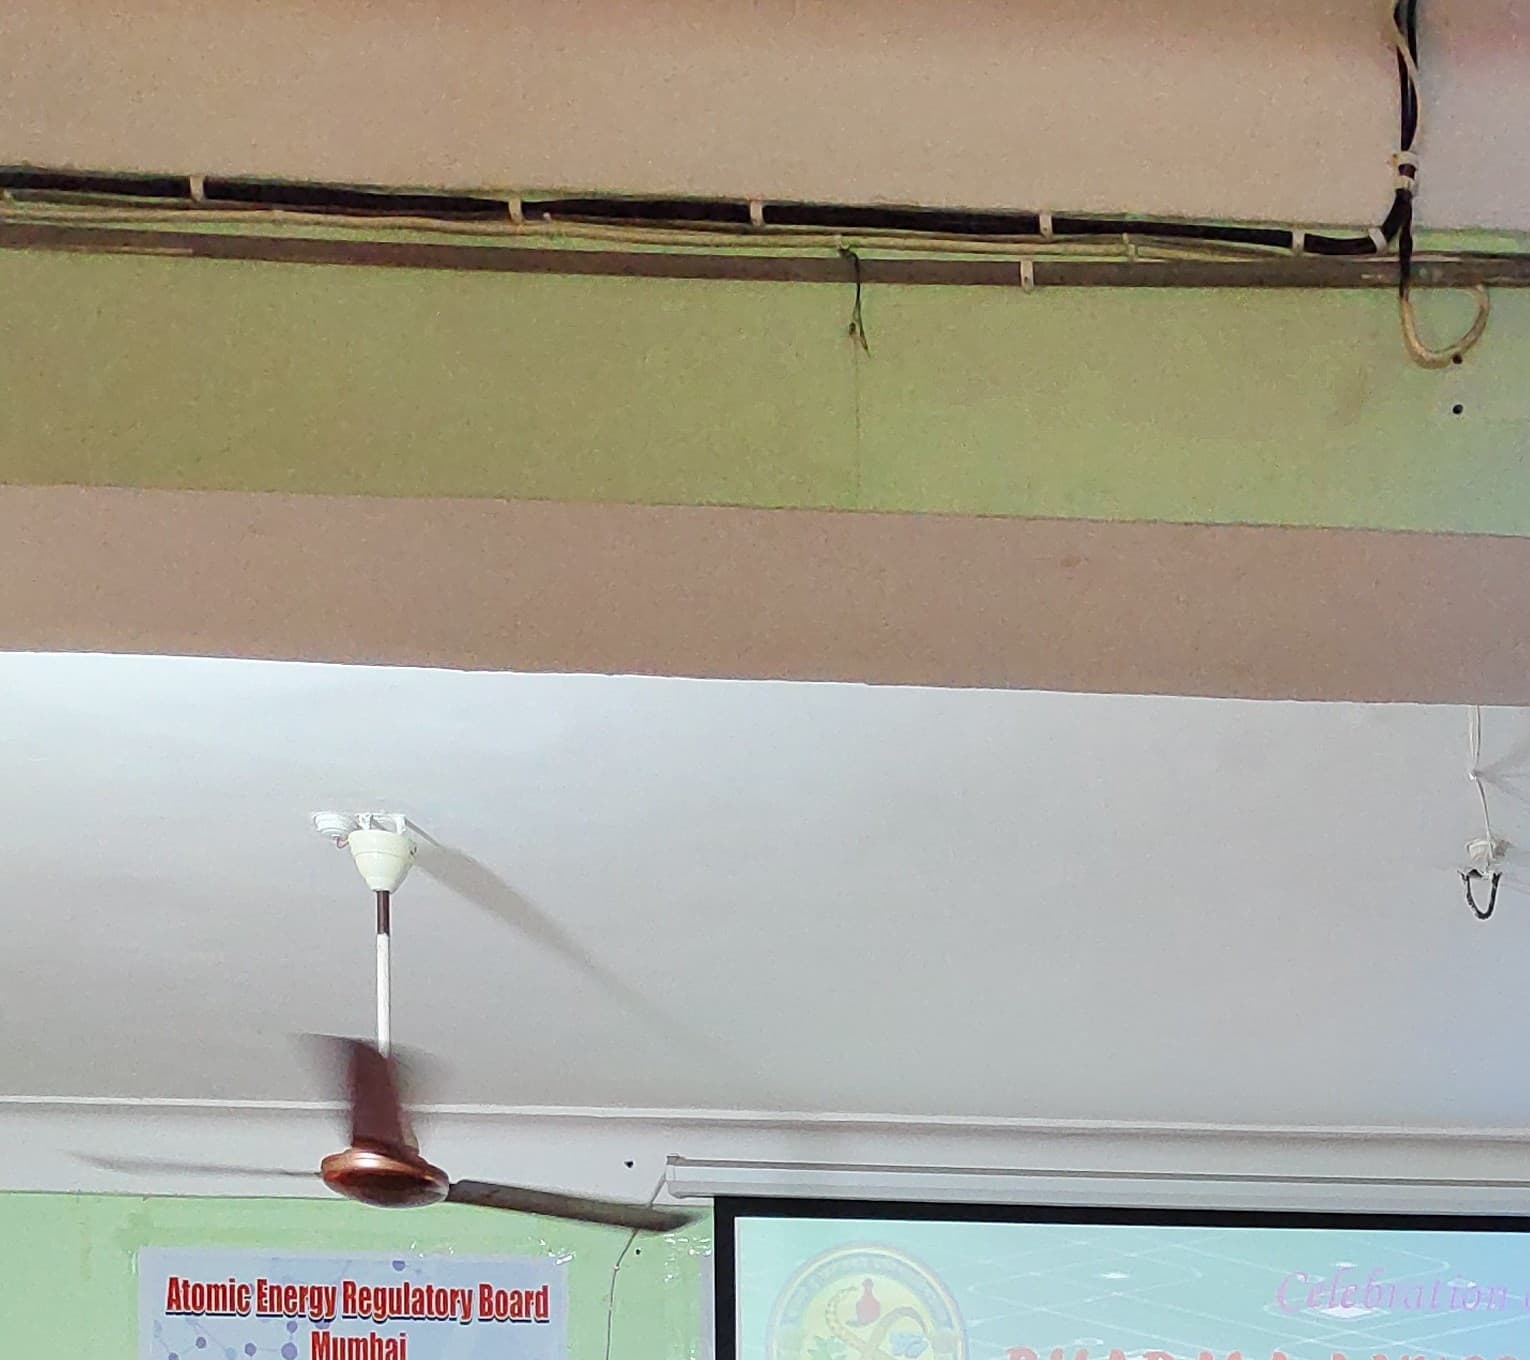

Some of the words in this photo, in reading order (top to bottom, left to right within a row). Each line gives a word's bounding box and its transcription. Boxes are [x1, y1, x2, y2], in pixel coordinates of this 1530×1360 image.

[166, 1277, 251, 1314] Atomic
[256, 1279, 337, 1319] Energy
[342, 1281, 473, 1320] Regulatory
[478, 1284, 549, 1319] Board
[1277, 1265, 1508, 1313] Celebration
